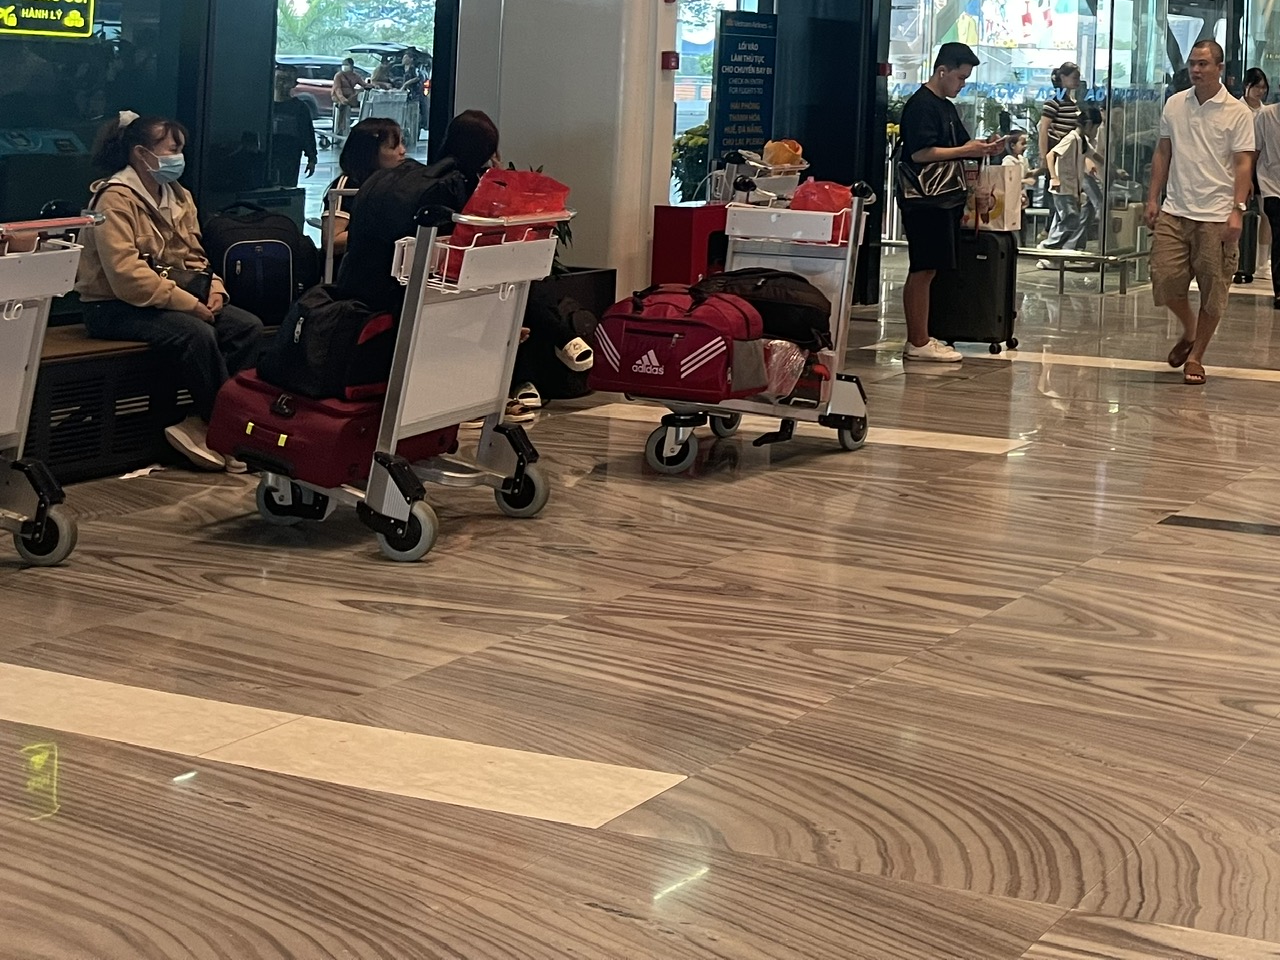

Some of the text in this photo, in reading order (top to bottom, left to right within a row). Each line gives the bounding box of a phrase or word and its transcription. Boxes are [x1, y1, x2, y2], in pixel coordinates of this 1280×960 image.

[21, 6, 63, 20] HÀNH LÝ
[632, 365, 664, 375] adidas
